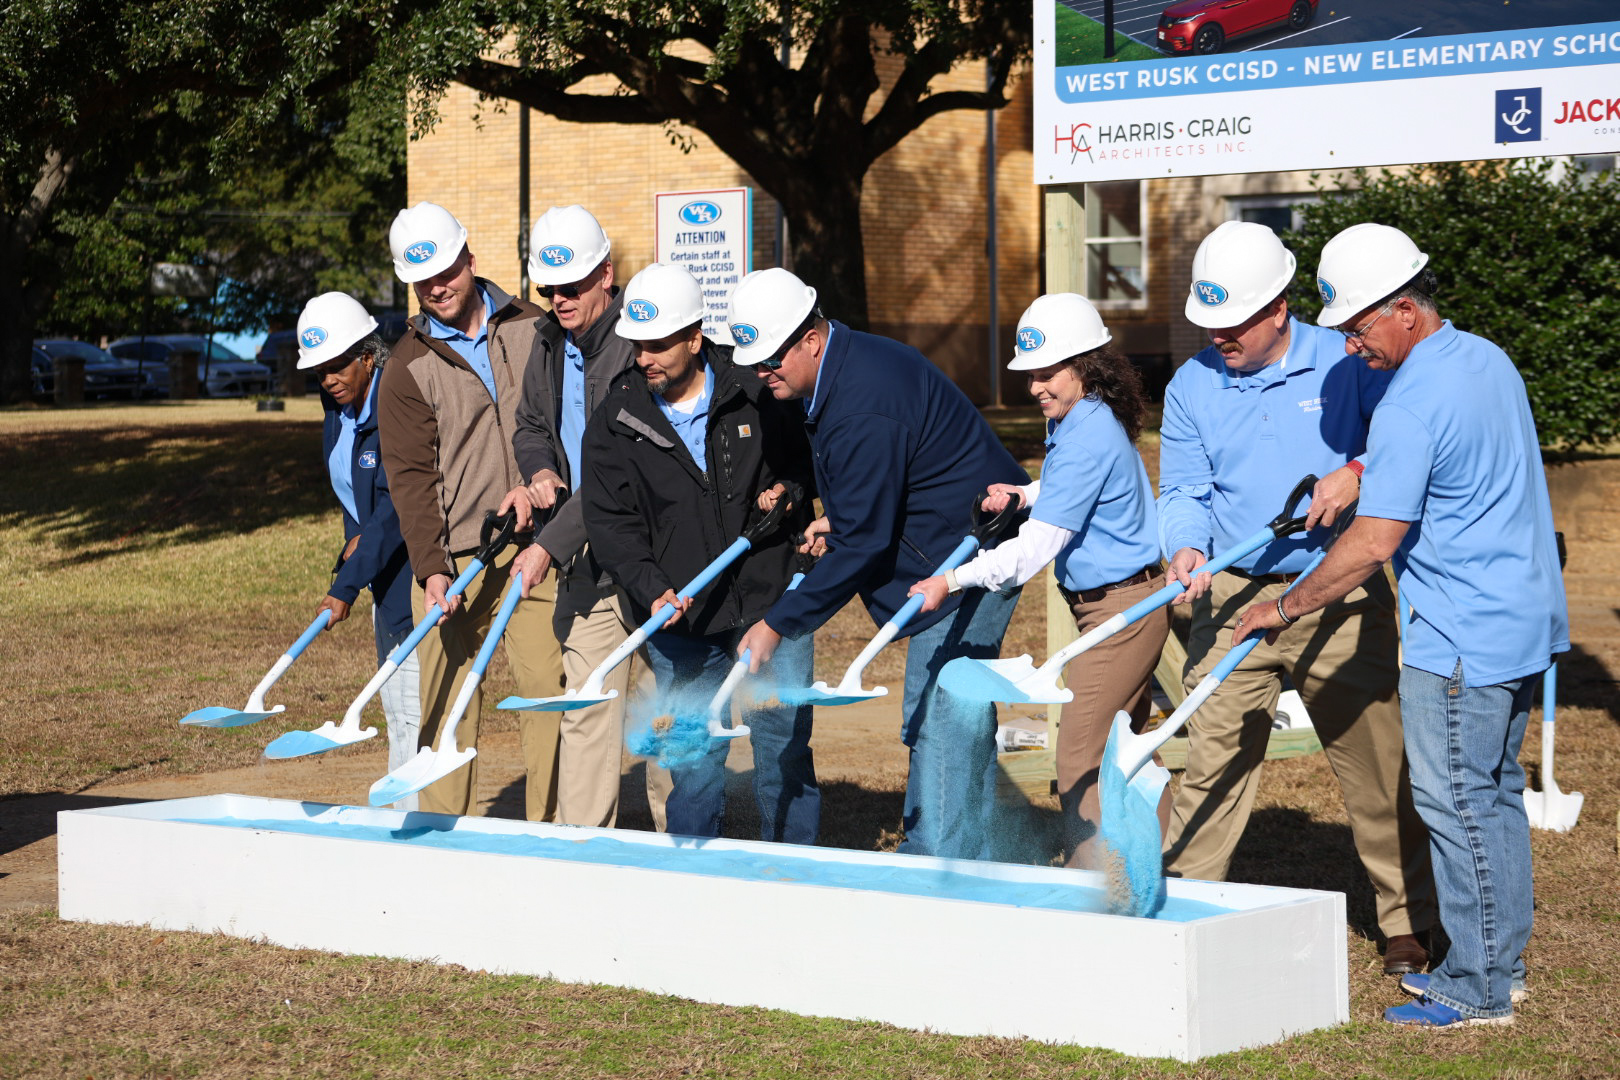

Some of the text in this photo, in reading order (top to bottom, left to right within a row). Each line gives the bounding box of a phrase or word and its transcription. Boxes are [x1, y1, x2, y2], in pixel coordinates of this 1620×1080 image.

[1066, 71, 1129, 93] WEST
[1138, 65, 1199, 88] RUSK
[1206, 60, 1278, 82] CCISD
[1304, 53, 1362, 75] NEW
[1372, 38, 1544, 70] ELEMENTARY
[1099, 141, 1252, 161] ARCHITECTS INC.
[675, 230, 726, 244] ATTENTION
[670, 250, 731, 261] Certain staff at
[688, 262, 735, 273] Rusk CCISD
[705, 276, 721, 285] and
[723, 275, 738, 284] will
[714, 315, 728, 323] our
